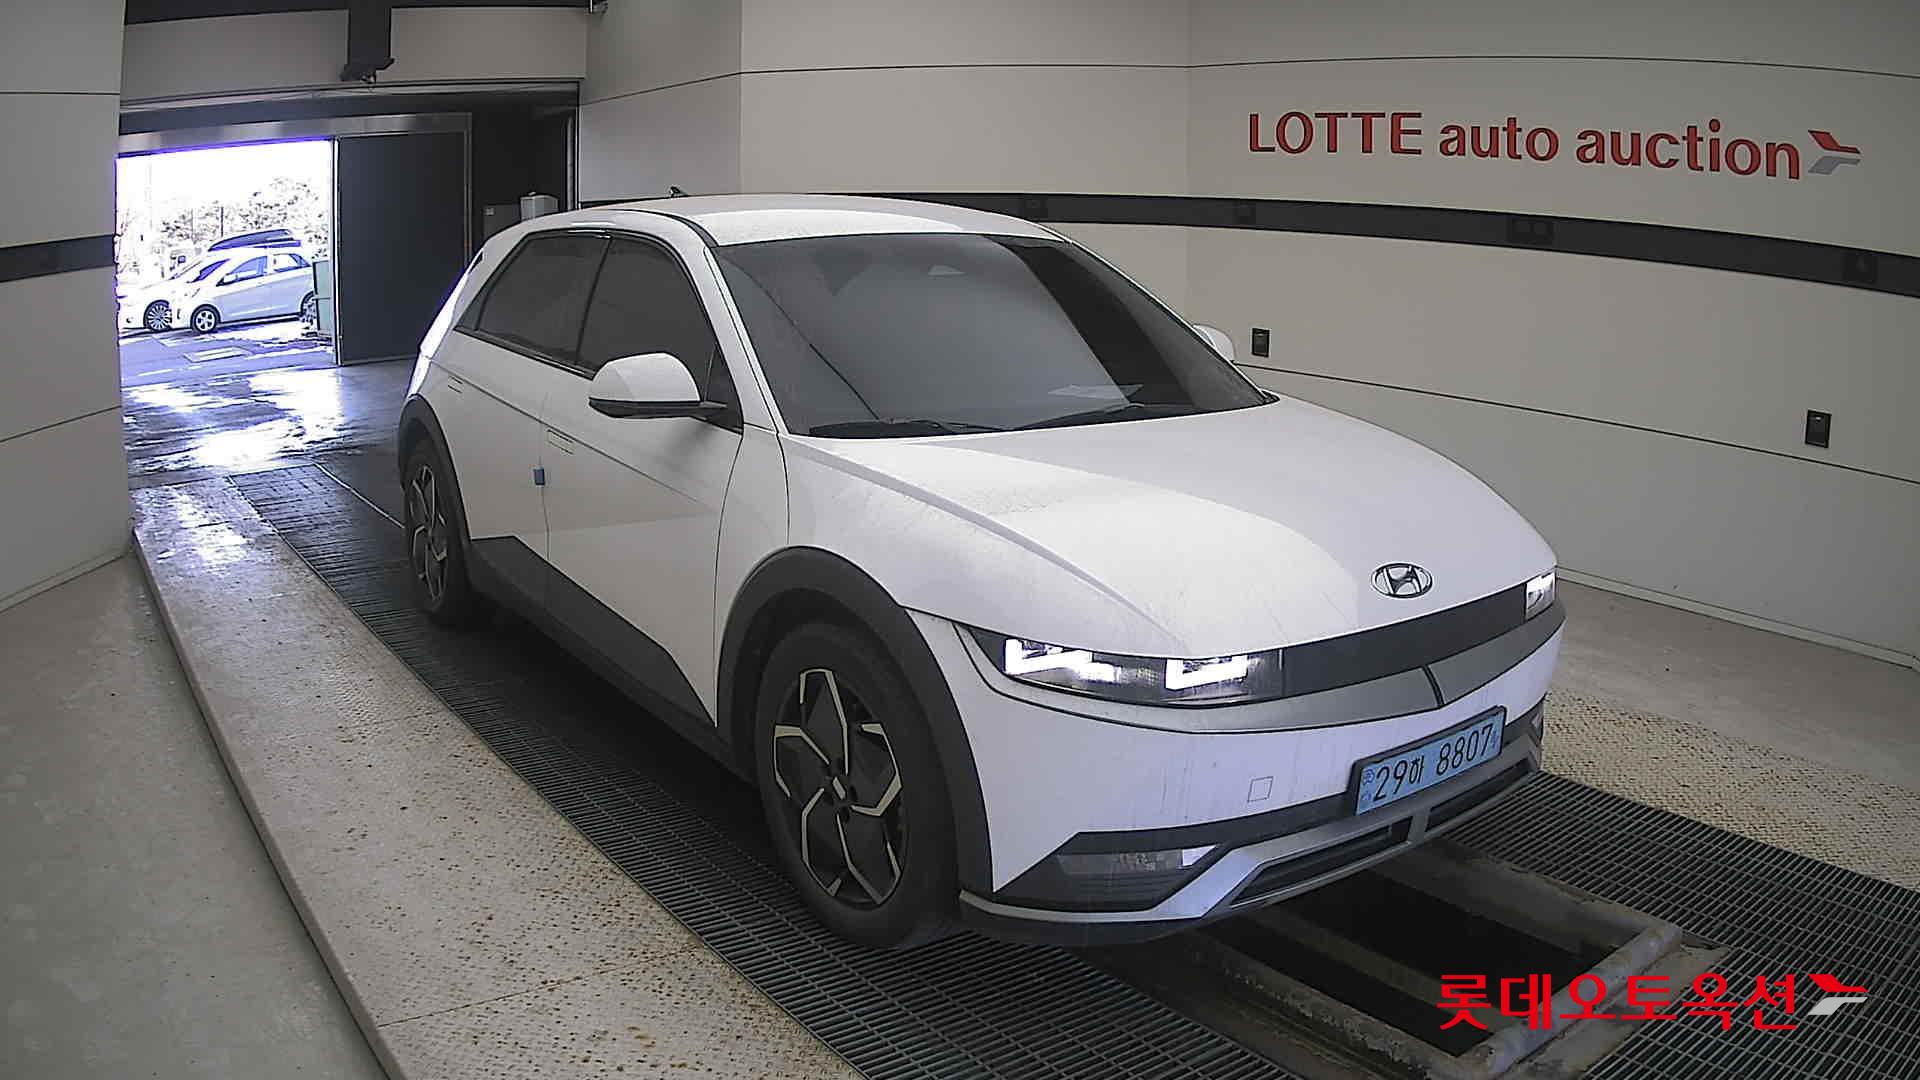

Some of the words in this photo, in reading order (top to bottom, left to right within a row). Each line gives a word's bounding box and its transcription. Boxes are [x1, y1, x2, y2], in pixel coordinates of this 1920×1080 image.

[1248, 111, 1423, 155] LOTTE
[1439, 116, 1560, 161] auto
[1576, 119, 1801, 180] auction
[1373, 755, 1425, 802] 29하
[1436, 723, 1494, 776] 8807
